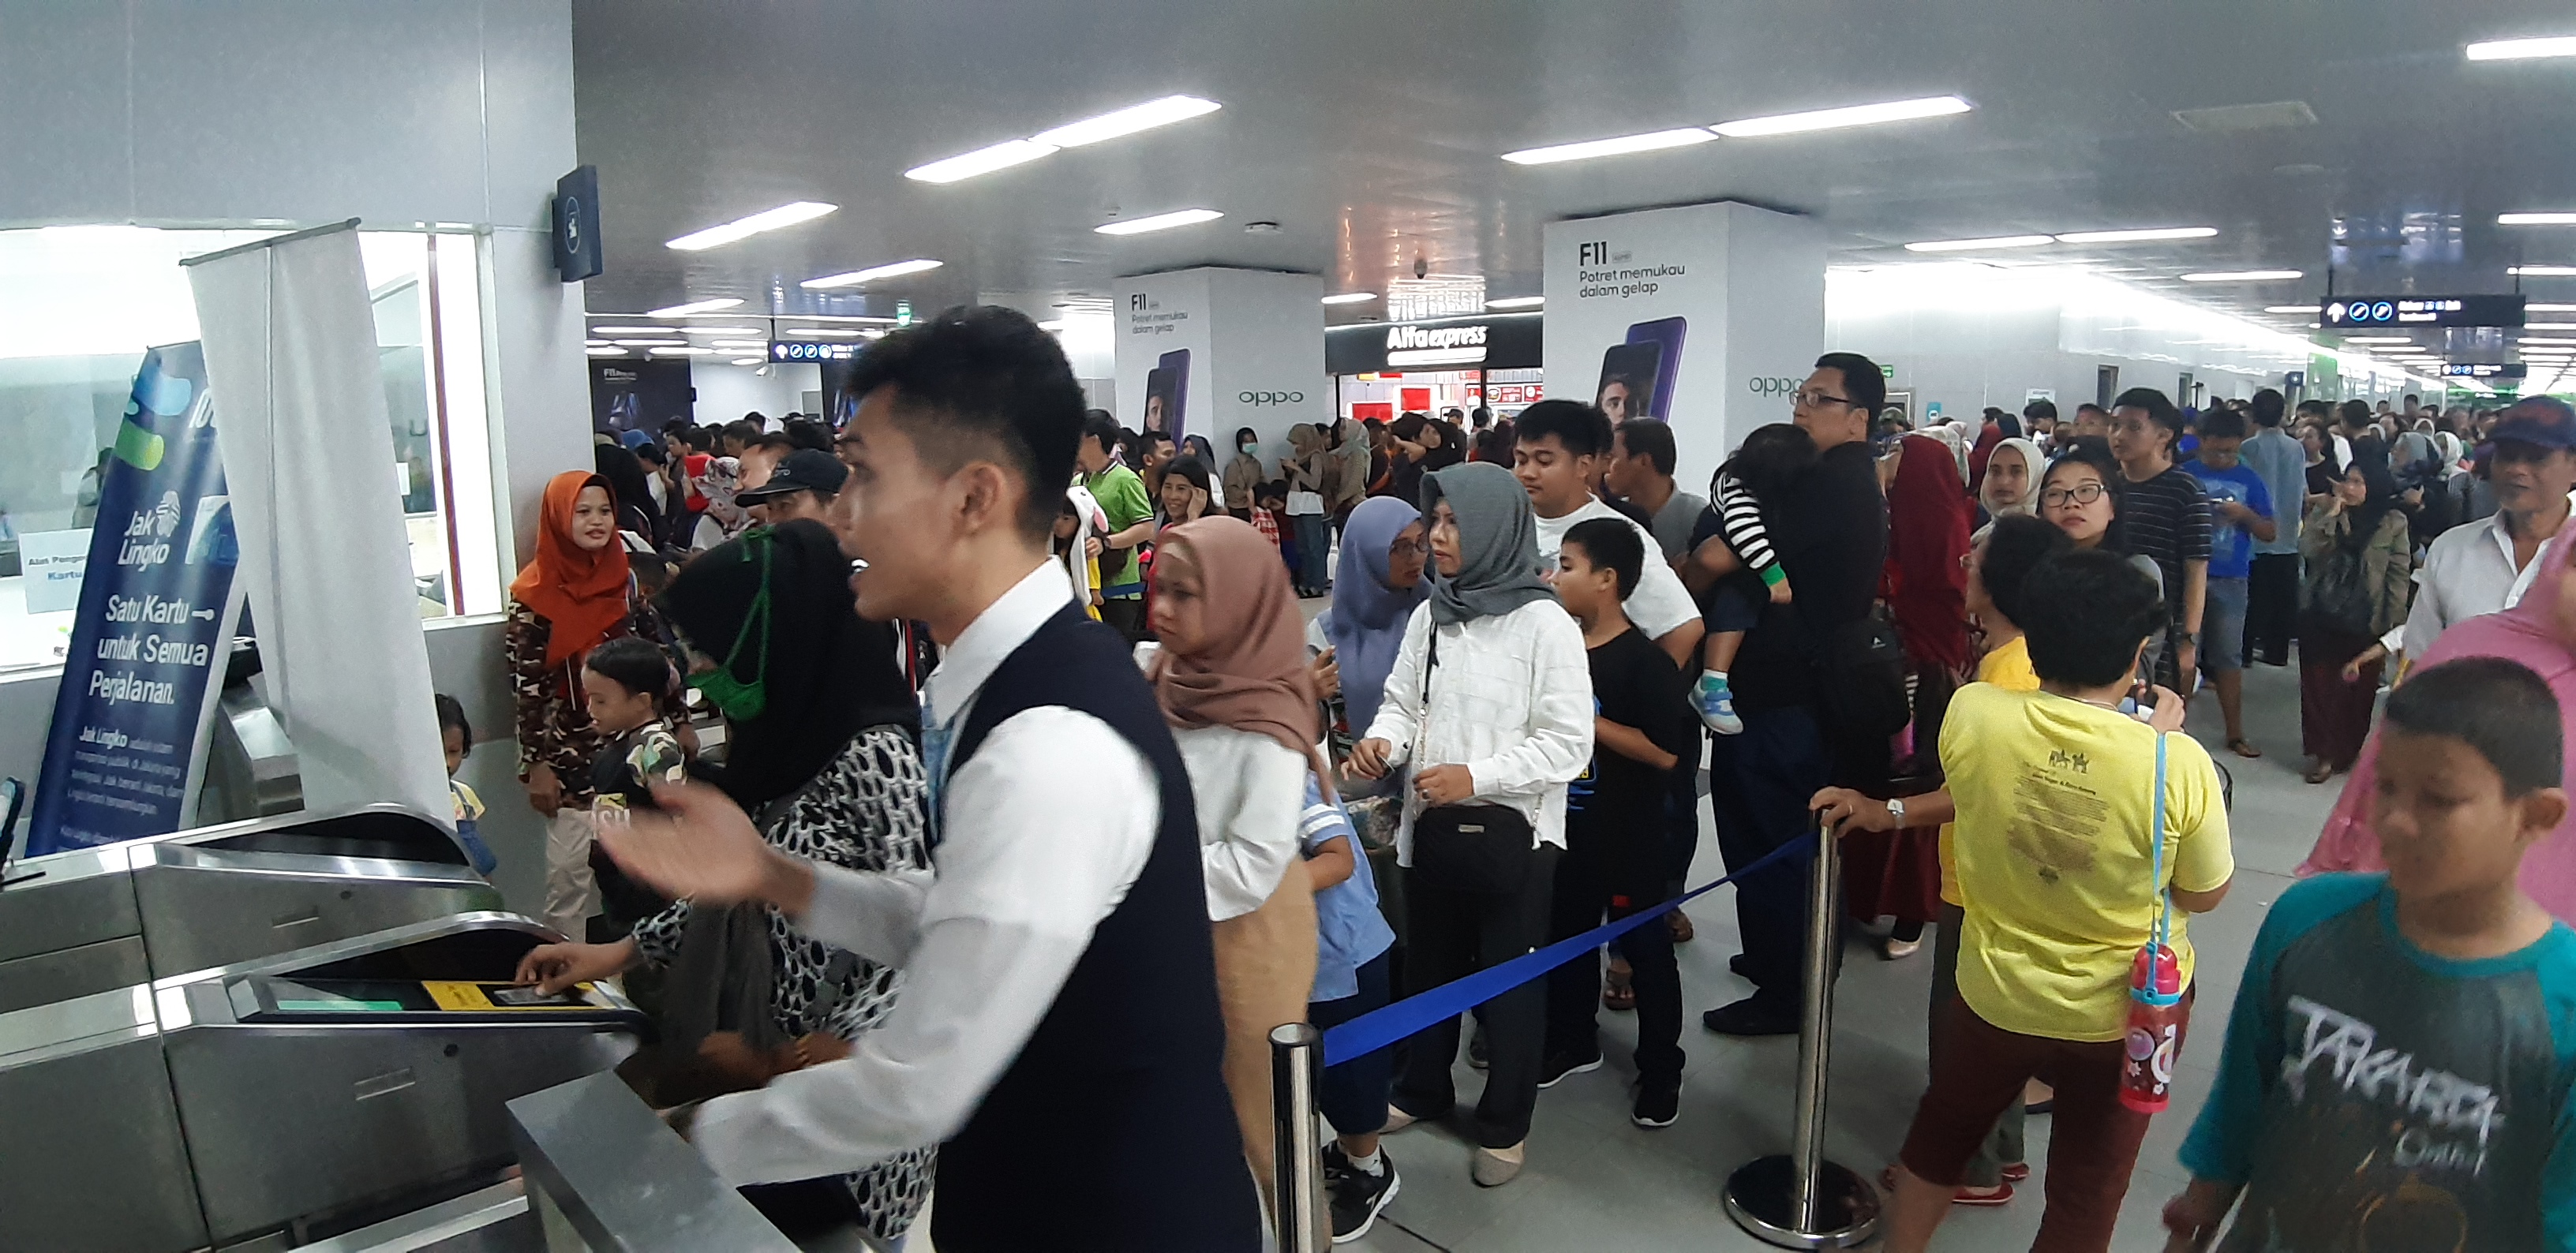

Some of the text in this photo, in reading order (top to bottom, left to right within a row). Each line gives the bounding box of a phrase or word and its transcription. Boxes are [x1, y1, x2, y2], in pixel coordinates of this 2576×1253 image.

[1580, 241, 1607, 267] F11
[1580, 264, 1685, 282] Potret memukau
[1132, 294, 1146, 311] F11
[1580, 281, 1658, 298] dalam gelap
[1239, 391, 1304, 406] oppo
[124, 510, 155, 537] Jak
[118, 538, 170, 572] Lingko
[105, 594, 190, 624] Satu Kartu
[97, 633, 208, 666] untuk Semua
